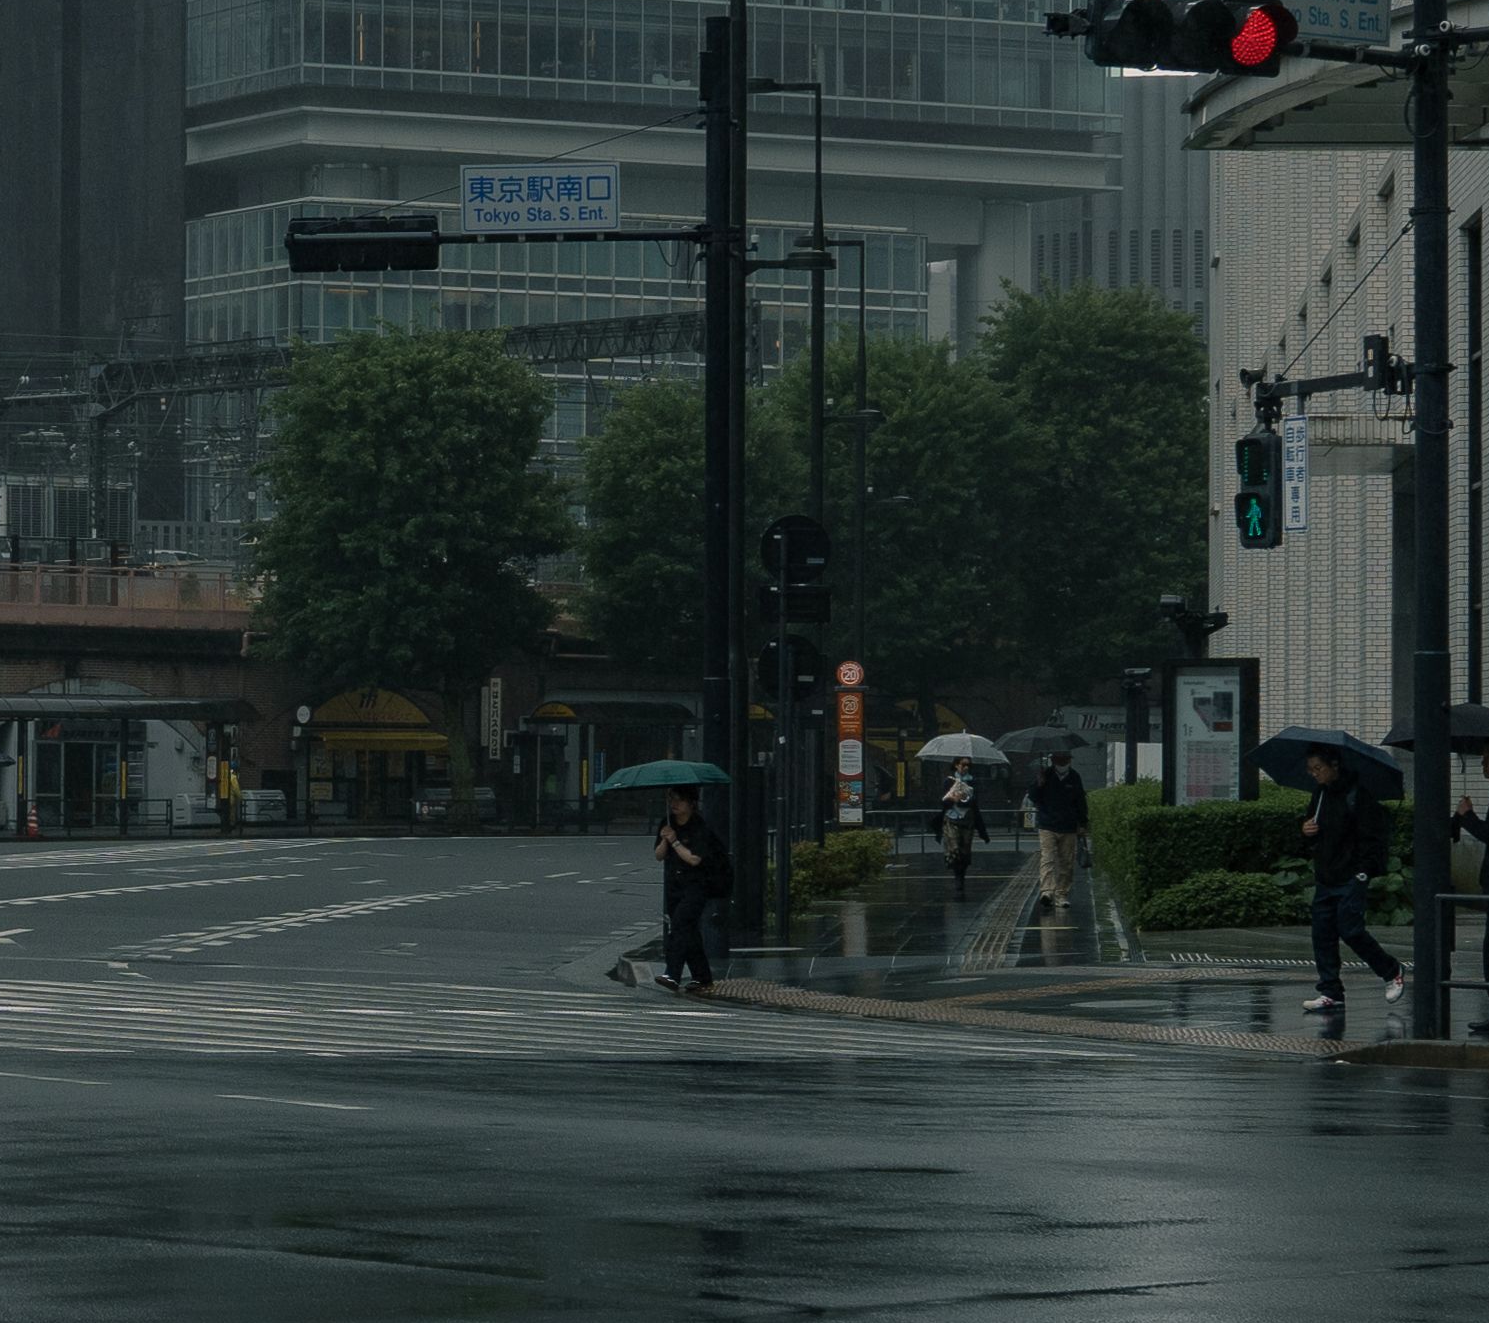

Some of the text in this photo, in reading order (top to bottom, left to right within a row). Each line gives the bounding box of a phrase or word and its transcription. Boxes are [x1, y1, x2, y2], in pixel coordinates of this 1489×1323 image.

[1308, 6, 1332, 26] Sta.
[1339, 9, 1352, 29] S.
[1358, 12, 1383, 33] Ent.
[467, 175, 611, 204] 東京駅南口
[474, 206, 608, 225] Tokyo Sta. S. Ent.
